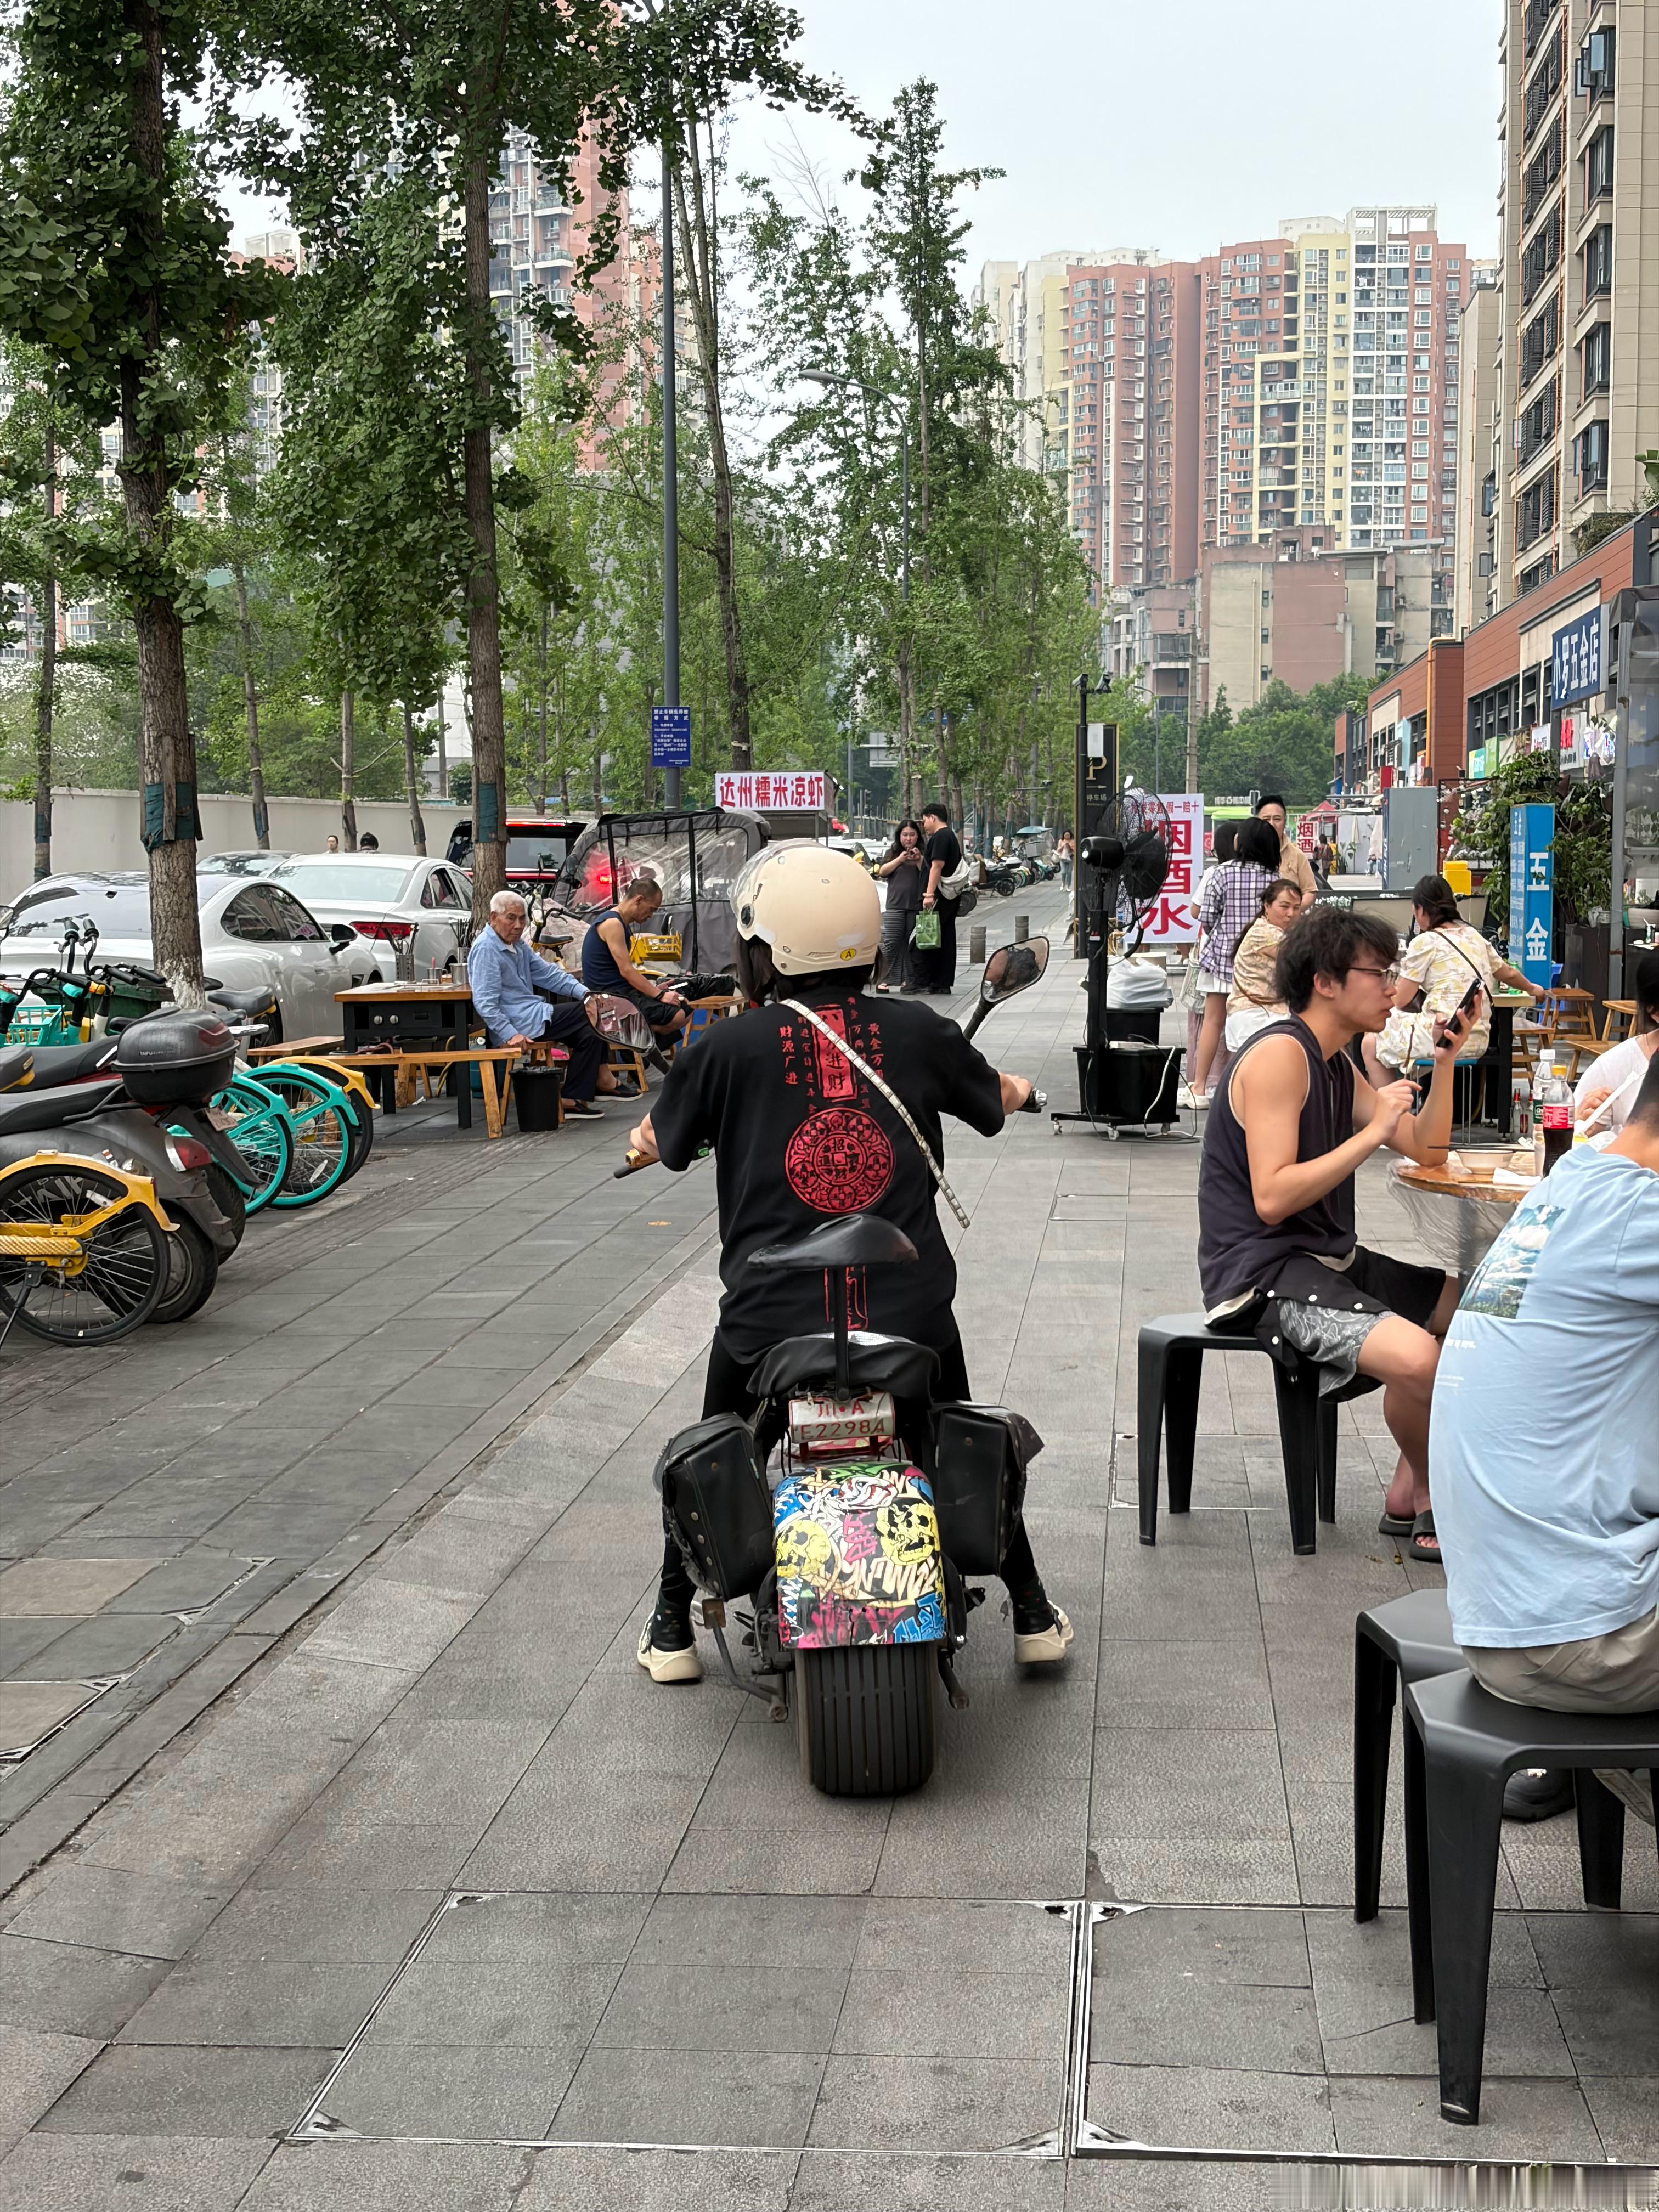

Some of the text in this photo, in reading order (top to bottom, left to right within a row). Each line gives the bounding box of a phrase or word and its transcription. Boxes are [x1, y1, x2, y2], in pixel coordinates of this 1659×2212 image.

[1553, 617, 1599, 701] 小罗五金店
[1086, 755, 1107, 780] P
[720, 775, 823, 808] 达州糯米凉虾
[1297, 822, 1314, 853] 烟酒
[1526, 852, 1549, 961] 五金
[779, 1025, 798, 1085] 财源广进
[800, 1419, 885, 1440] E2298A
